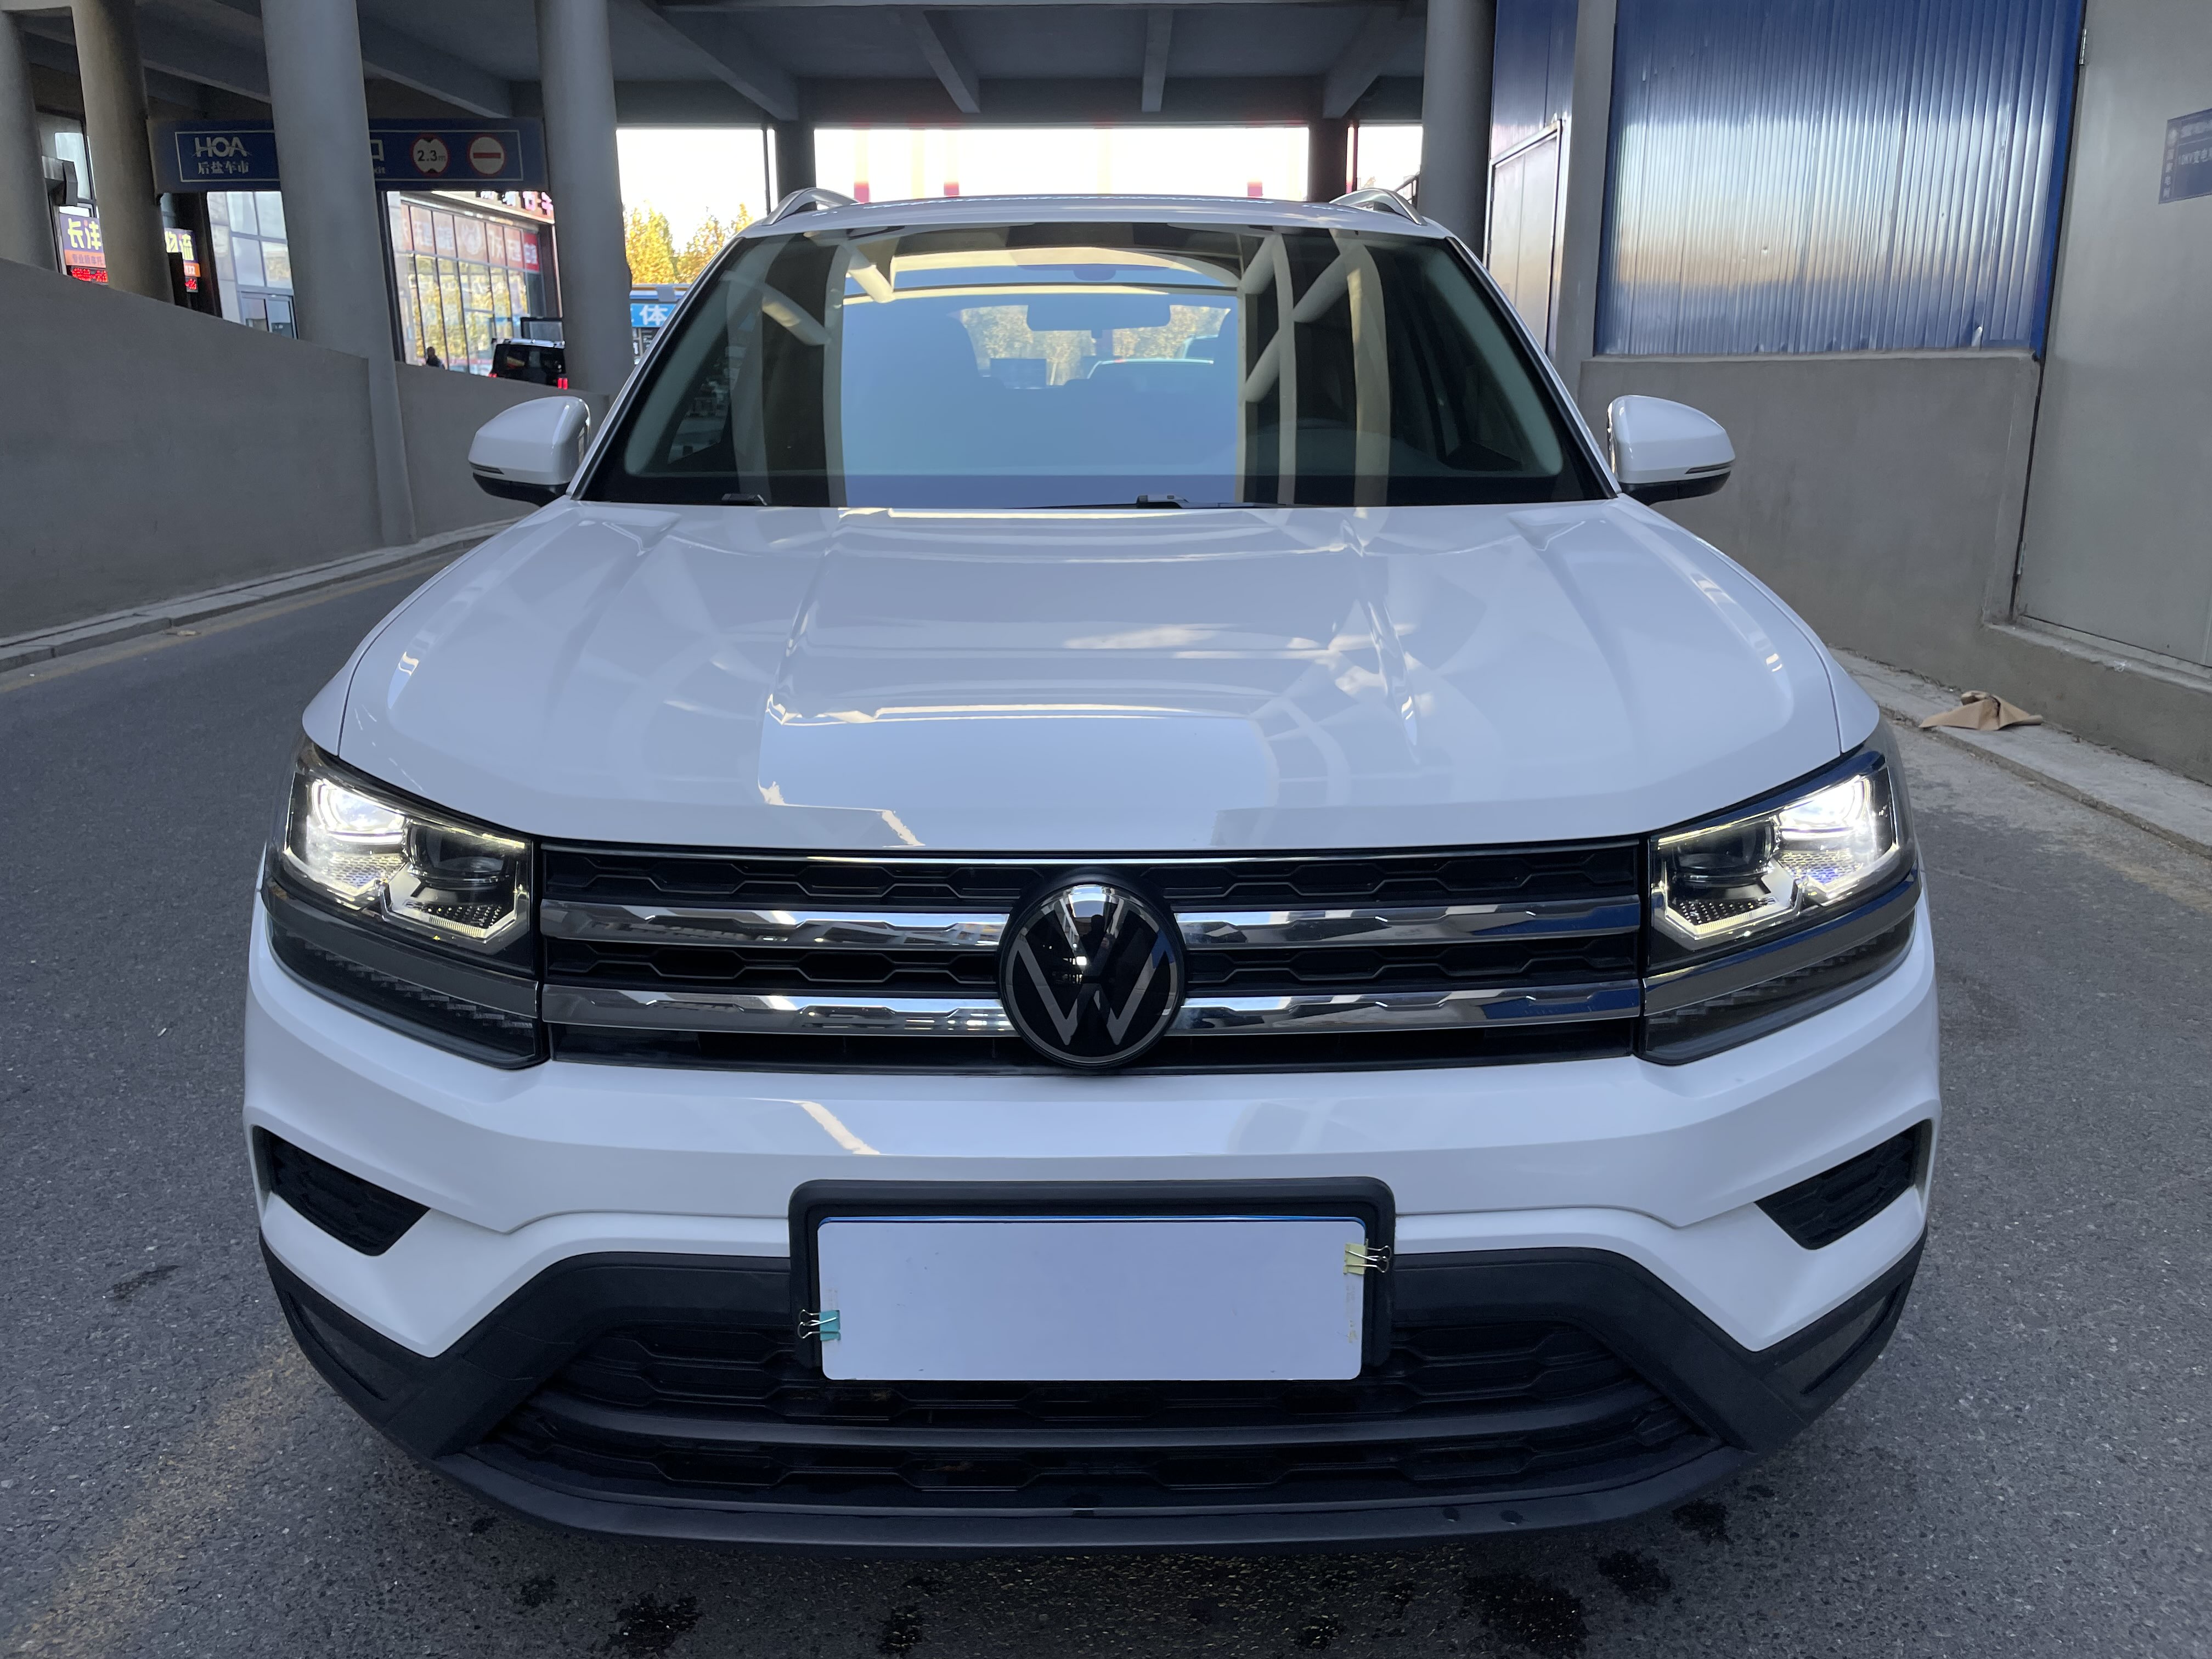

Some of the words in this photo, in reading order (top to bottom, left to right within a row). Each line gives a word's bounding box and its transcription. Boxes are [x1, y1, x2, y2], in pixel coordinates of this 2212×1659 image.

[194, 137, 248, 157] HOA
[370, 139, 384, 161] 口
[198, 160, 249, 174] 后盐车市
[630, 305, 668, 325] 体
